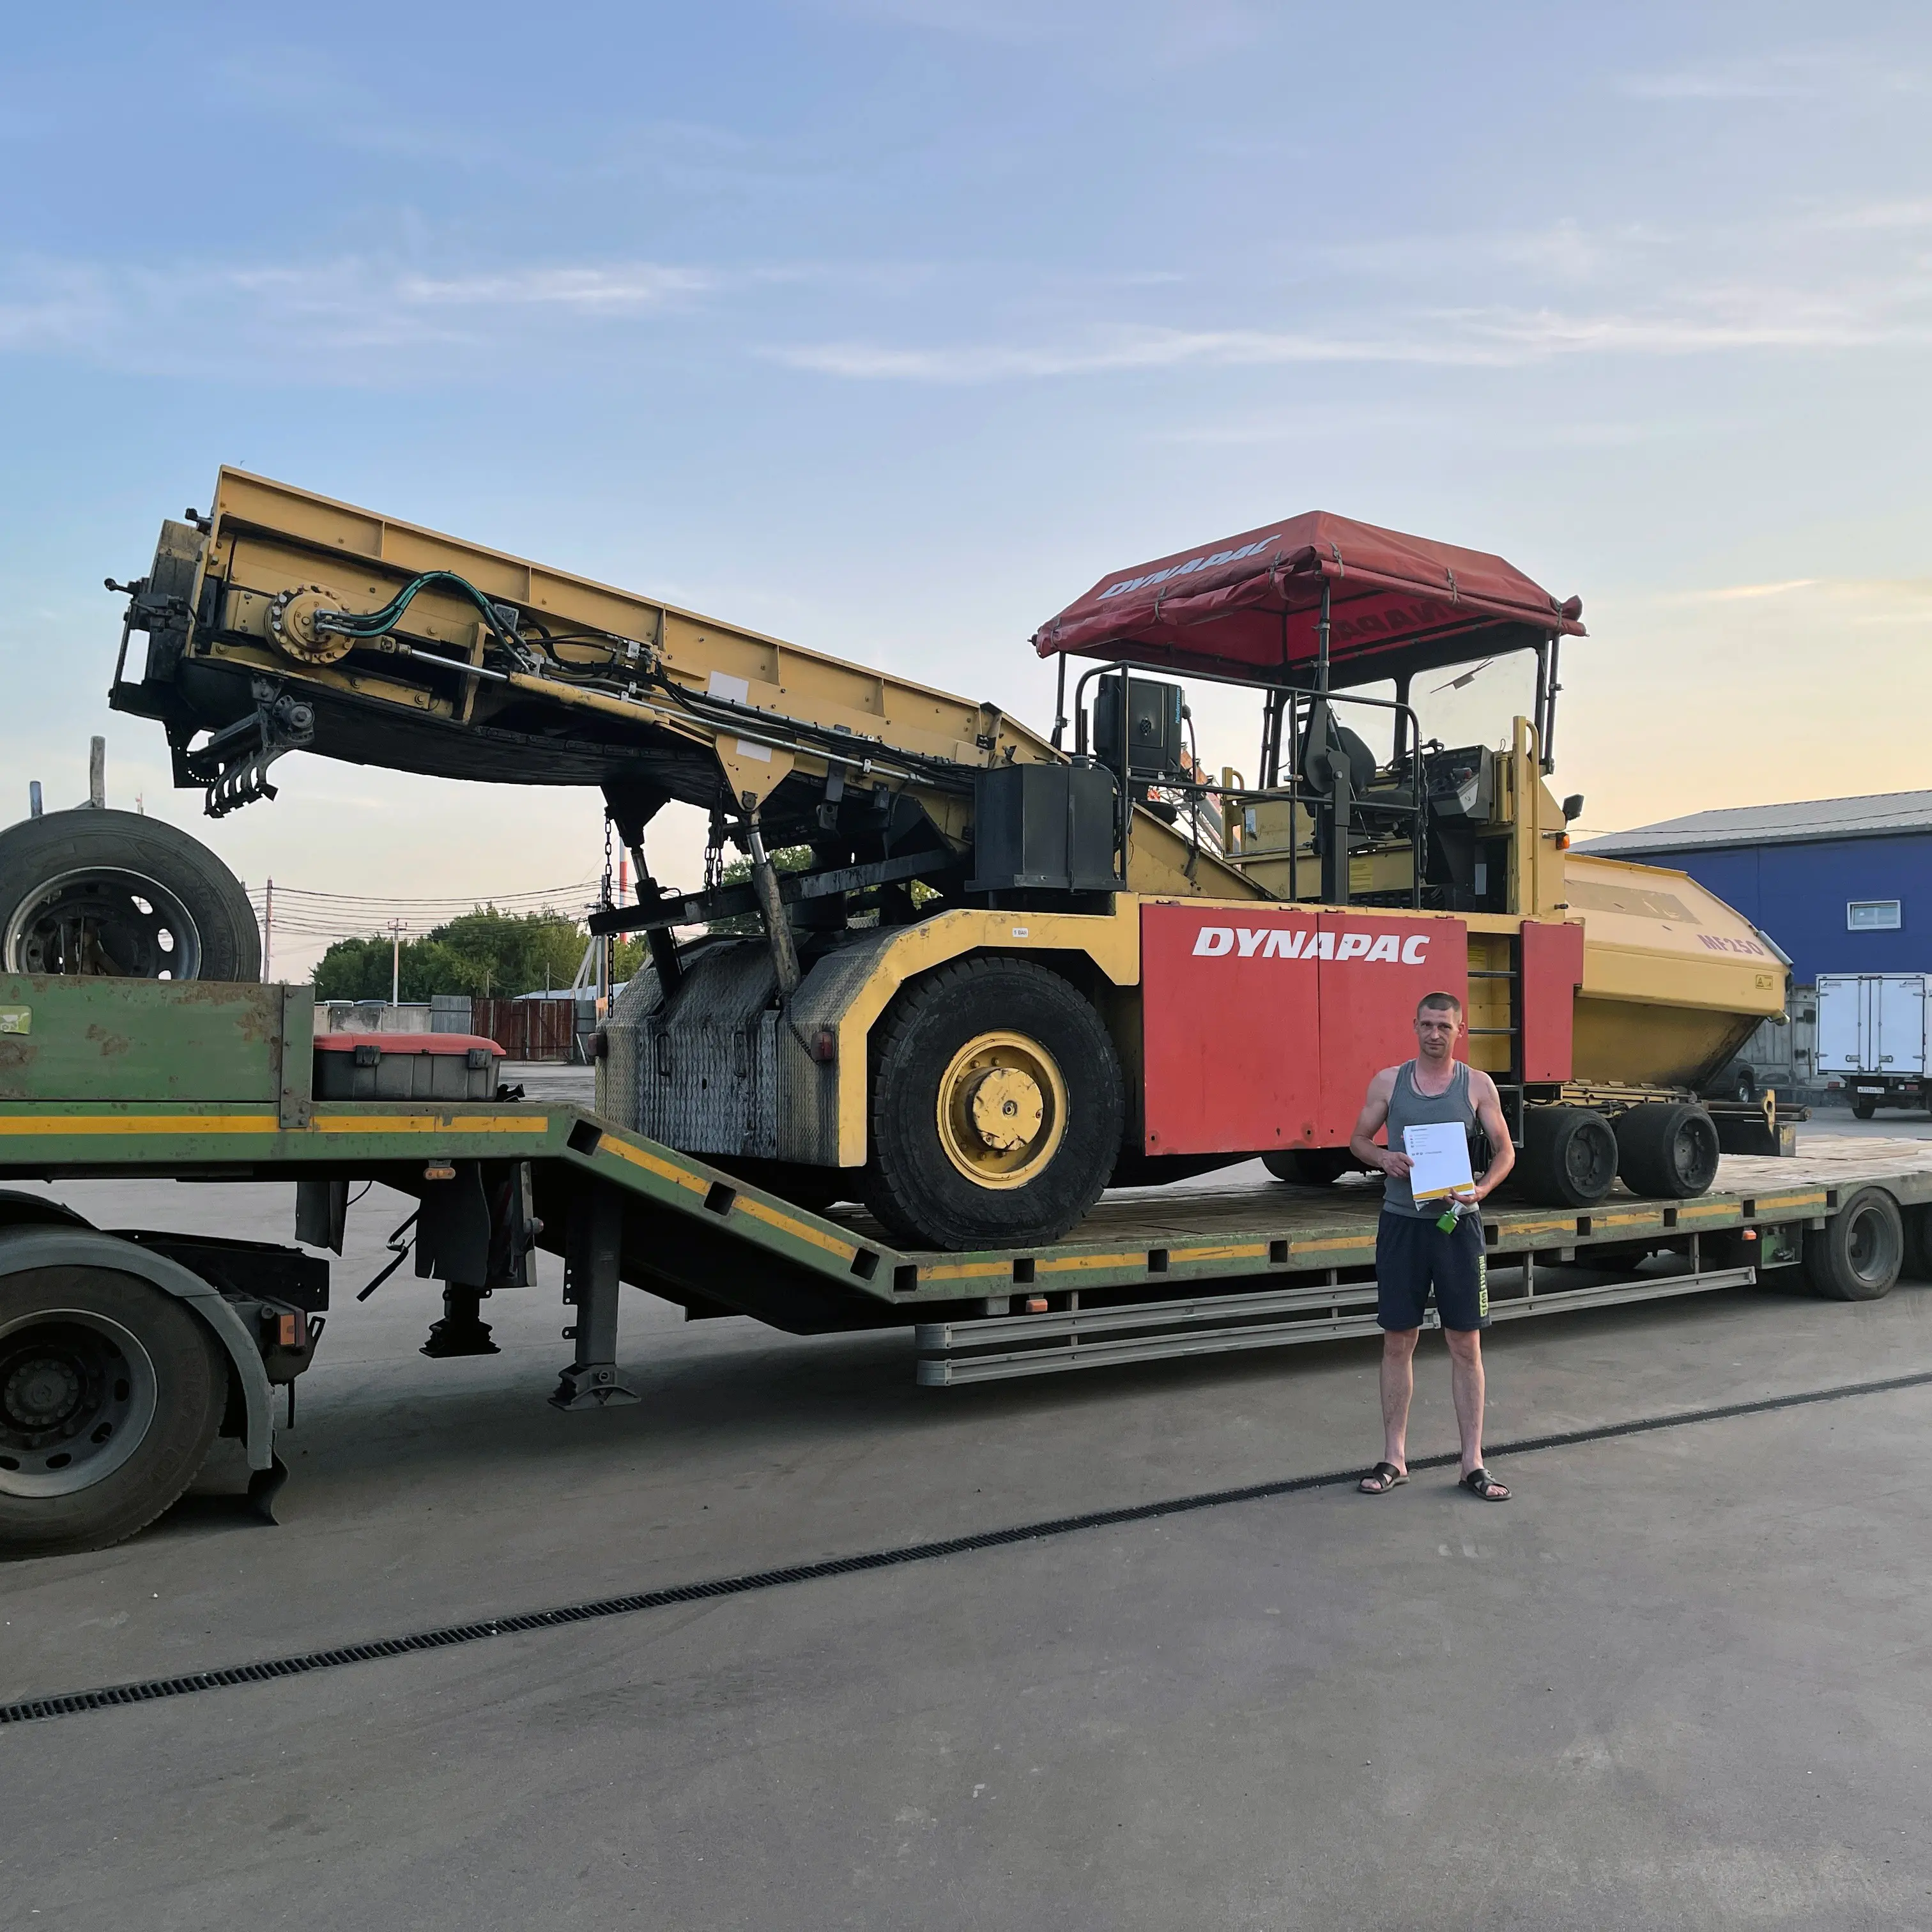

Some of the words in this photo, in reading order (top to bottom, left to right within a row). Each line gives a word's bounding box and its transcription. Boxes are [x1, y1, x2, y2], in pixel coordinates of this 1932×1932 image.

[1096, 534, 1282, 600] DYNAPAC
[1192, 926, 1431, 965] DYNAPAC
[1697, 934, 1765, 956] MF250
